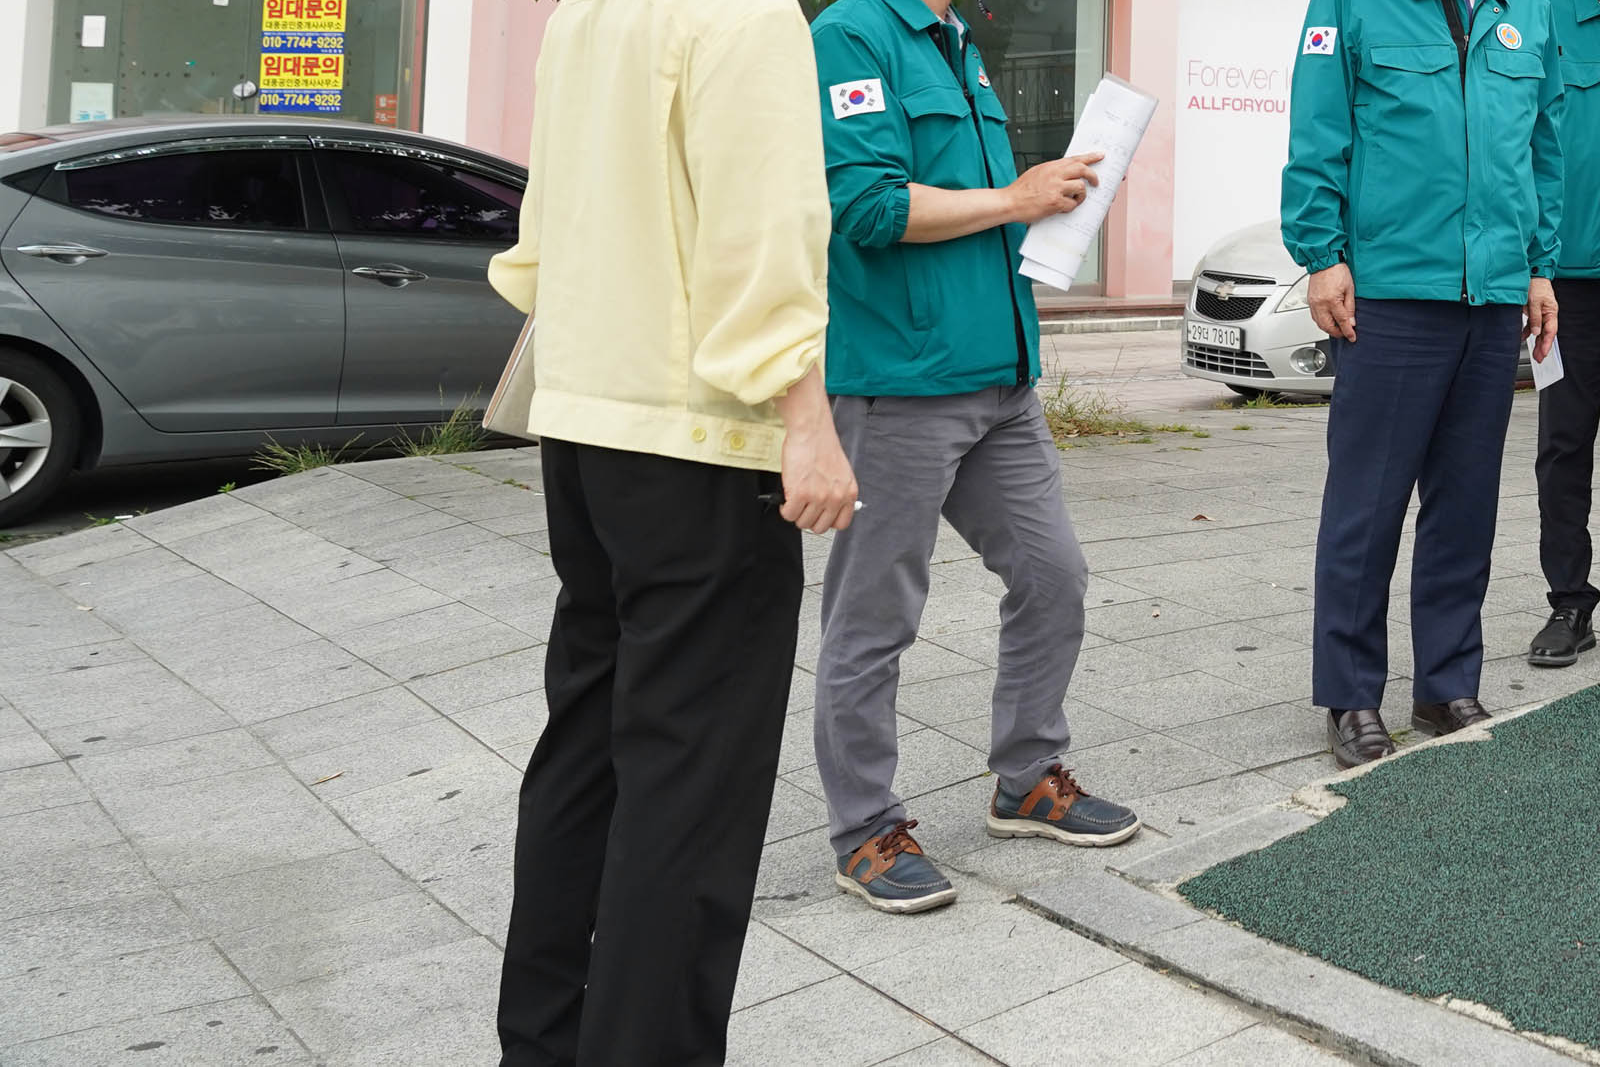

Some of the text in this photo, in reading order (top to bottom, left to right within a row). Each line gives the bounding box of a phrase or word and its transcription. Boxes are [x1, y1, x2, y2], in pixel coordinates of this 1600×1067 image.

[262, 36, 344, 49] 010-7744-9292
[264, 56, 340, 77] 임대문의
[1187, 59, 1280, 91] Forever
[260, 93, 342, 106] 010-7744-9292
[1187, 95, 1286, 114] ALLFORYOU
[1213, 328, 1235, 346] 7810
